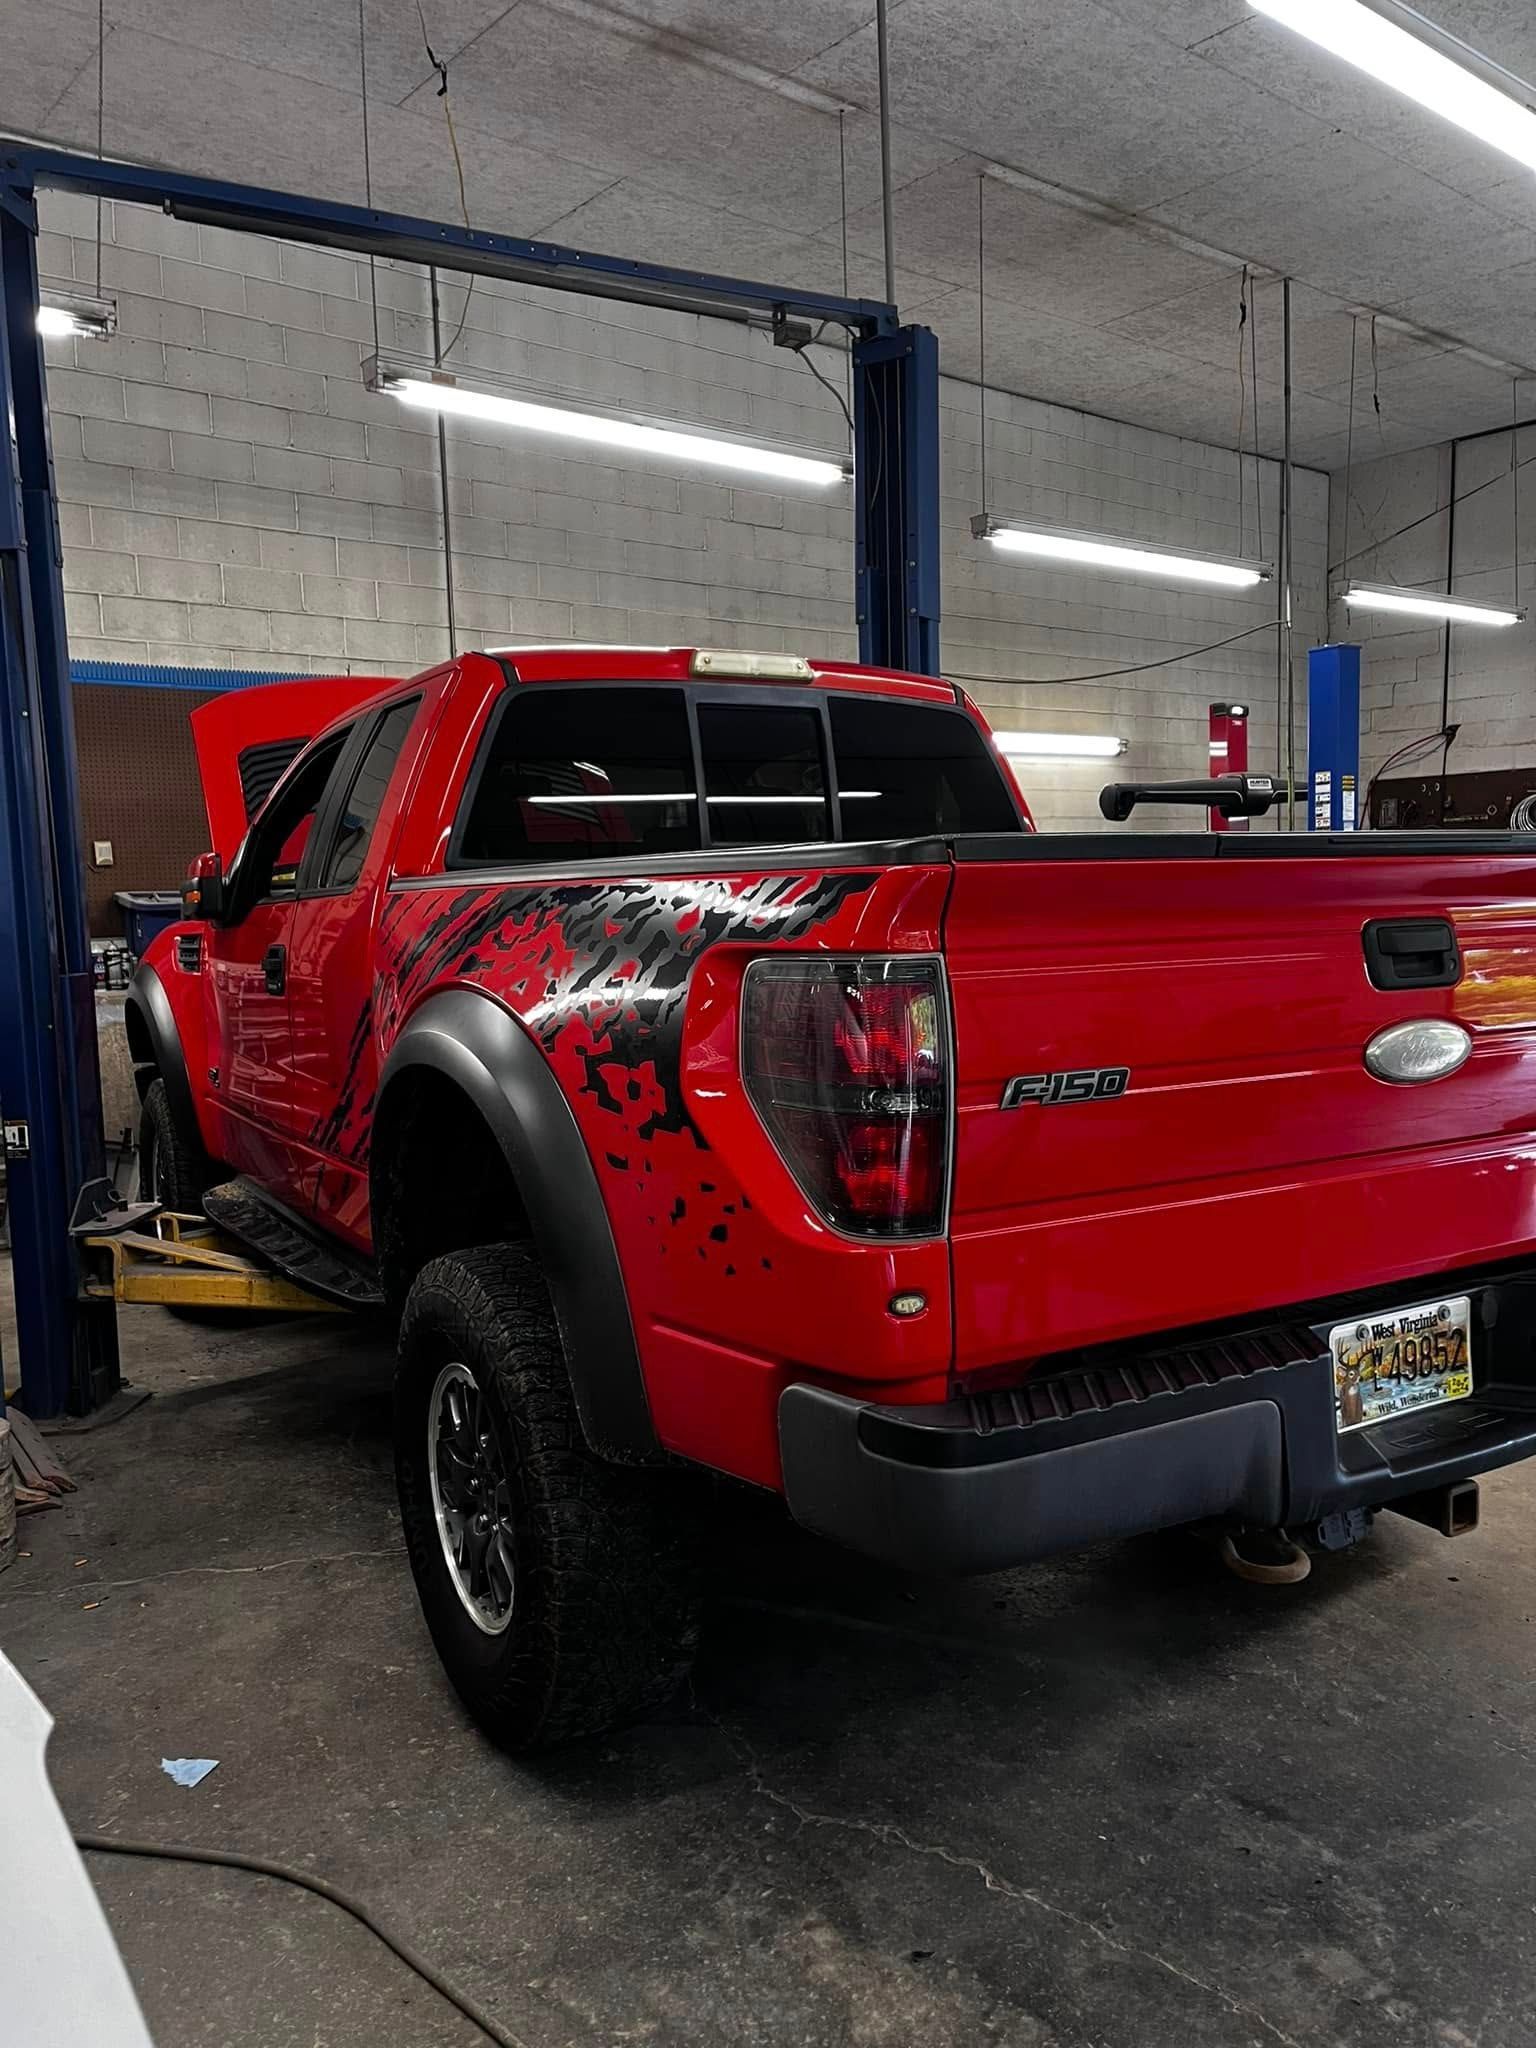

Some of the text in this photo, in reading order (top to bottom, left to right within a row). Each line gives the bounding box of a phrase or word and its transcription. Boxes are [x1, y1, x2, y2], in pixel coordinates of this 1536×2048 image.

[1000, 1066, 1131, 1110] F-150
[1371, 1311, 1439, 1341] West Virginia
[1389, 1328, 1467, 1385] 49852
[1400, 1387, 1440, 1407] Wonderful
